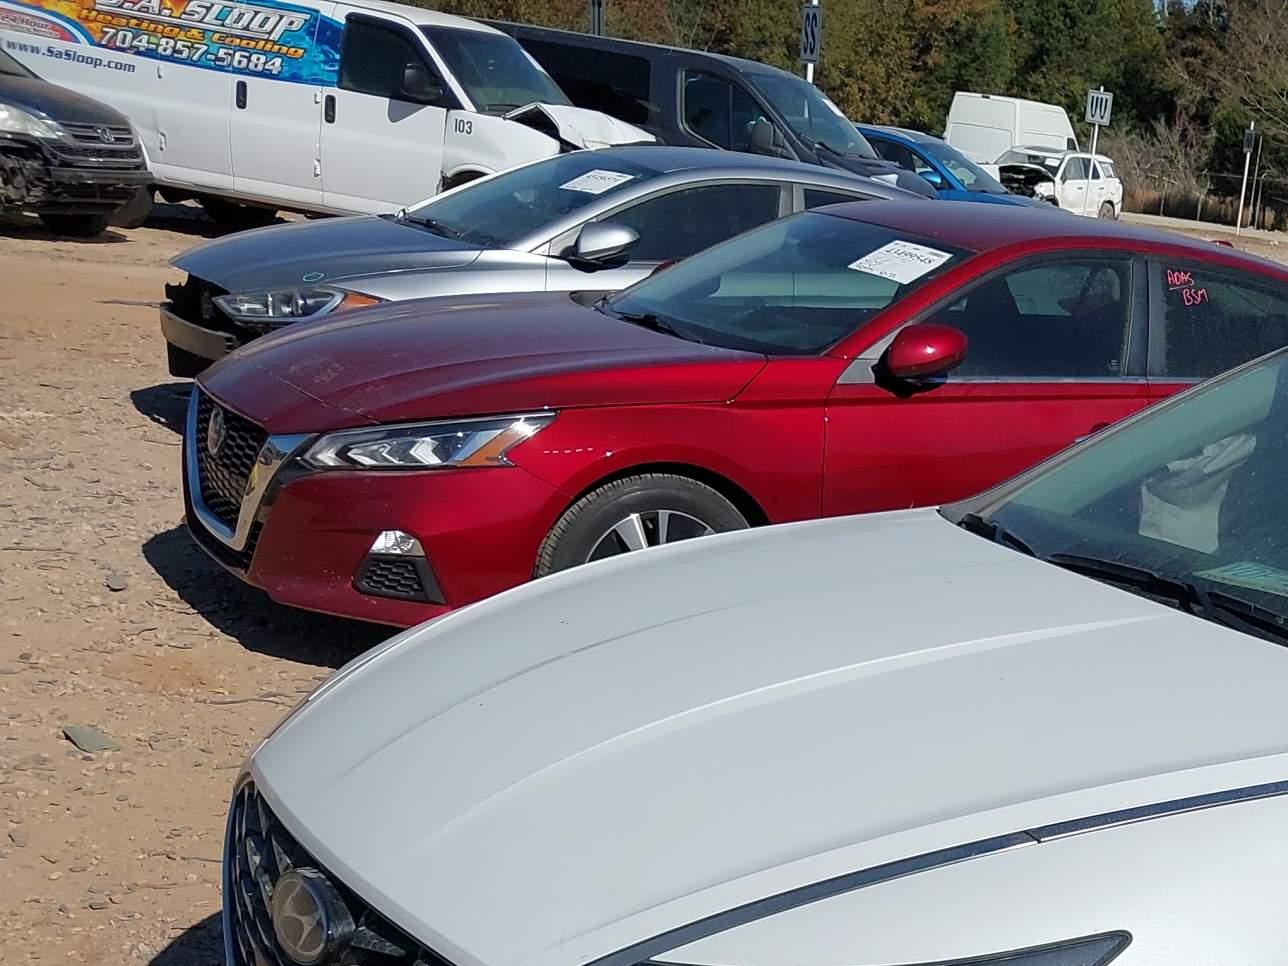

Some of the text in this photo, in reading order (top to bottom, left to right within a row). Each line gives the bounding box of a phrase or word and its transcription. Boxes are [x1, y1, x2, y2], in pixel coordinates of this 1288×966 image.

[79, 9, 305, 59] Heating & Cooling
[181, 2, 310, 40] SLOOP
[803, 12, 818, 55] SS
[6, 39, 136, 73] www.SaSloop.com
[101, 27, 283, 75] 704-857-5684
[454, 118, 473, 135] 103
[1183, 288, 1209, 306] BSM
